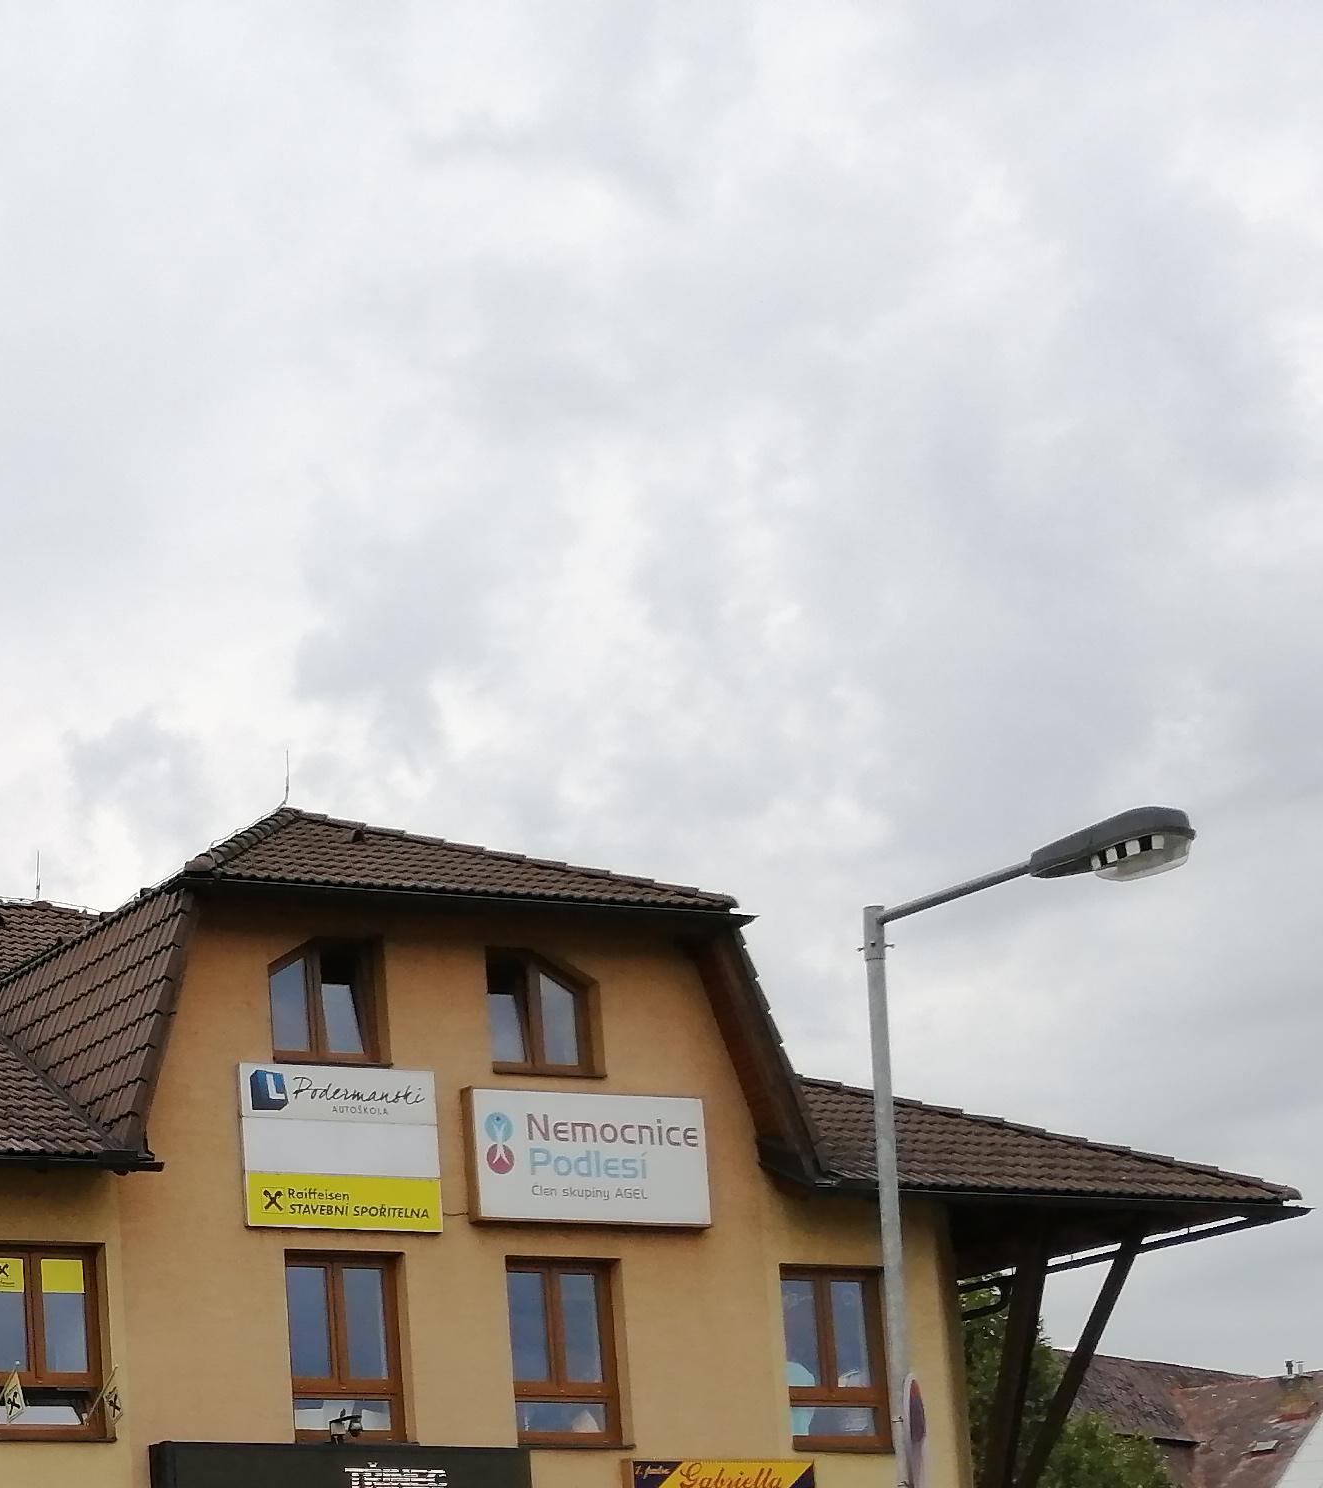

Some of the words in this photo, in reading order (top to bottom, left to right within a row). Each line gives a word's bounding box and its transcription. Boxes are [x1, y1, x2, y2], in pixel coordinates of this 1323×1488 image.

[293, 1076, 426, 1105] Podermanski
[332, 1105, 389, 1116] AUTOŠKOLA
[526, 1113, 699, 1147] Nemocnice
[529, 1147, 648, 1179] Podlesí
[288, 1188, 350, 1201] Raiffeisen
[562, 1186, 610, 1201] skupiny
[615, 1187, 648, 1200] AGEL
[289, 1203, 349, 1217] STAVEBNÍ
[353, 1204, 430, 1219] SPOŘITELNA
